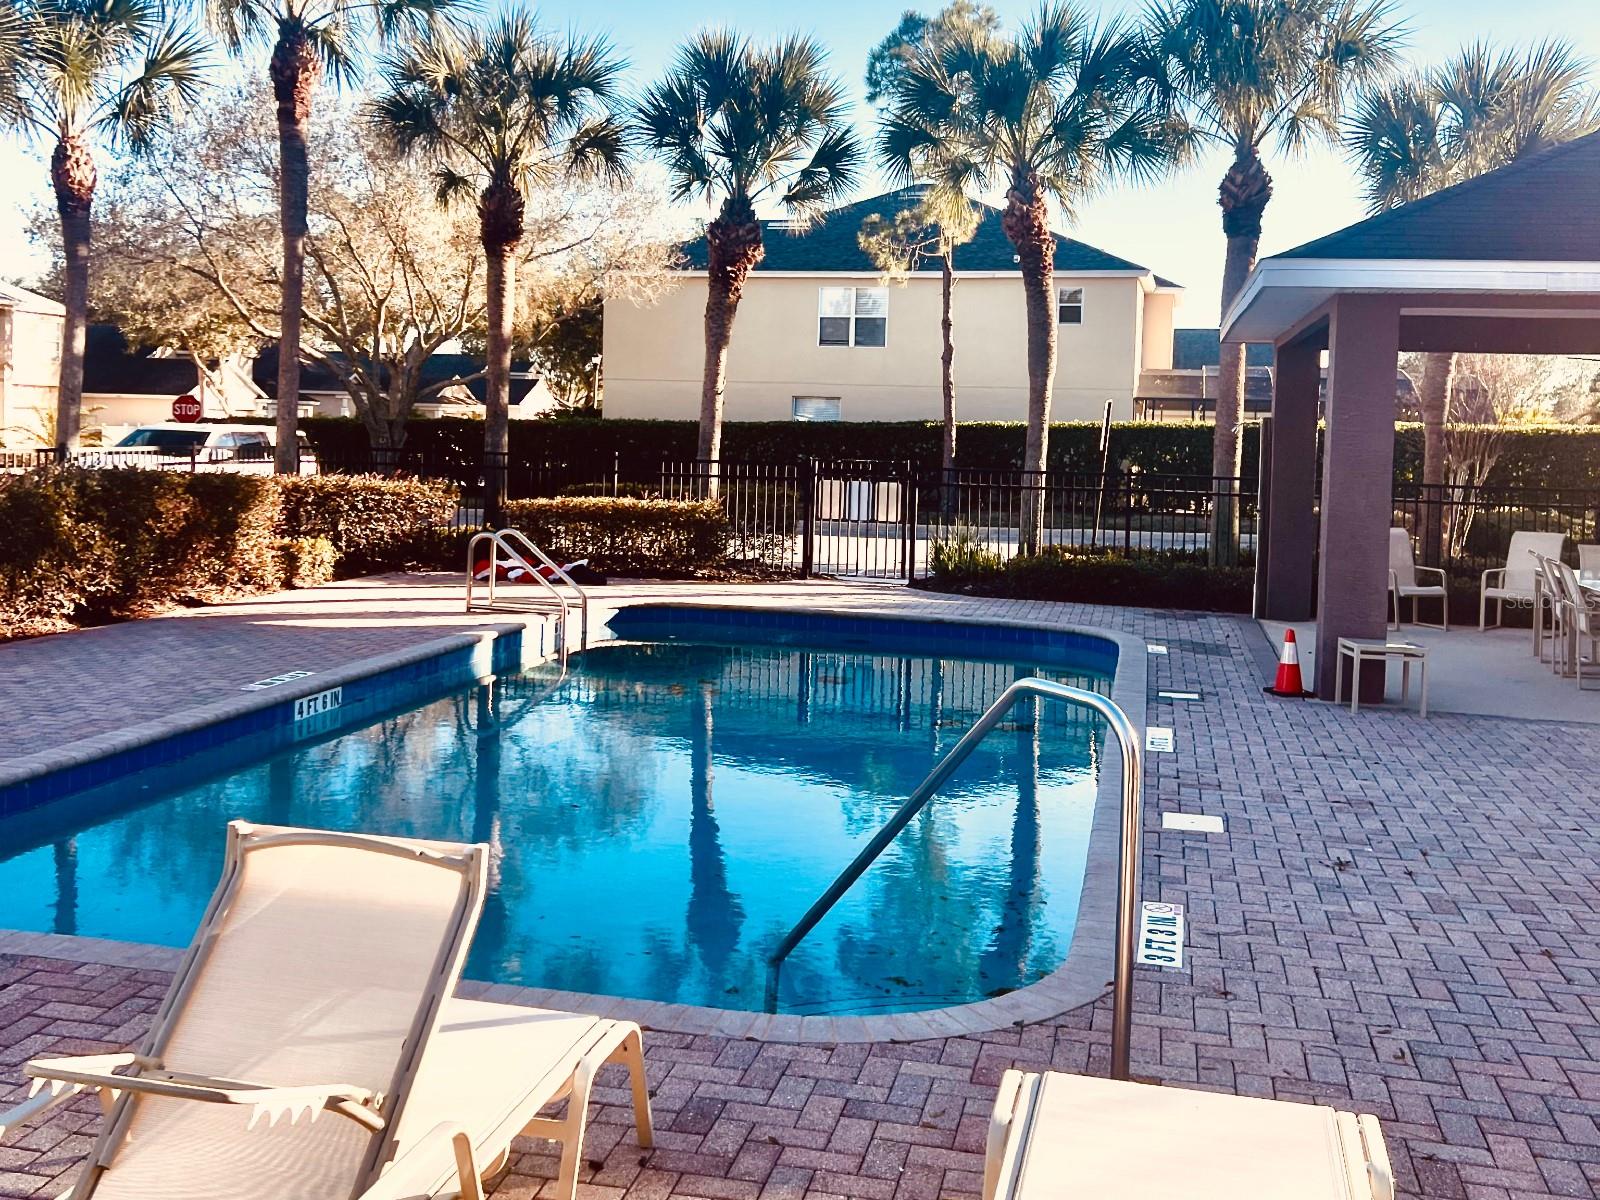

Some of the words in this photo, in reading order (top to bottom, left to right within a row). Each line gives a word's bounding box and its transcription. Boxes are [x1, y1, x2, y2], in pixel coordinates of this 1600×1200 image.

[174, 404, 200, 415] STOP
[297, 701, 304, 719] 4
[322, 694, 328, 710] 6
[1147, 928, 1177, 936] 3
[1144, 954, 1176, 963] 3
